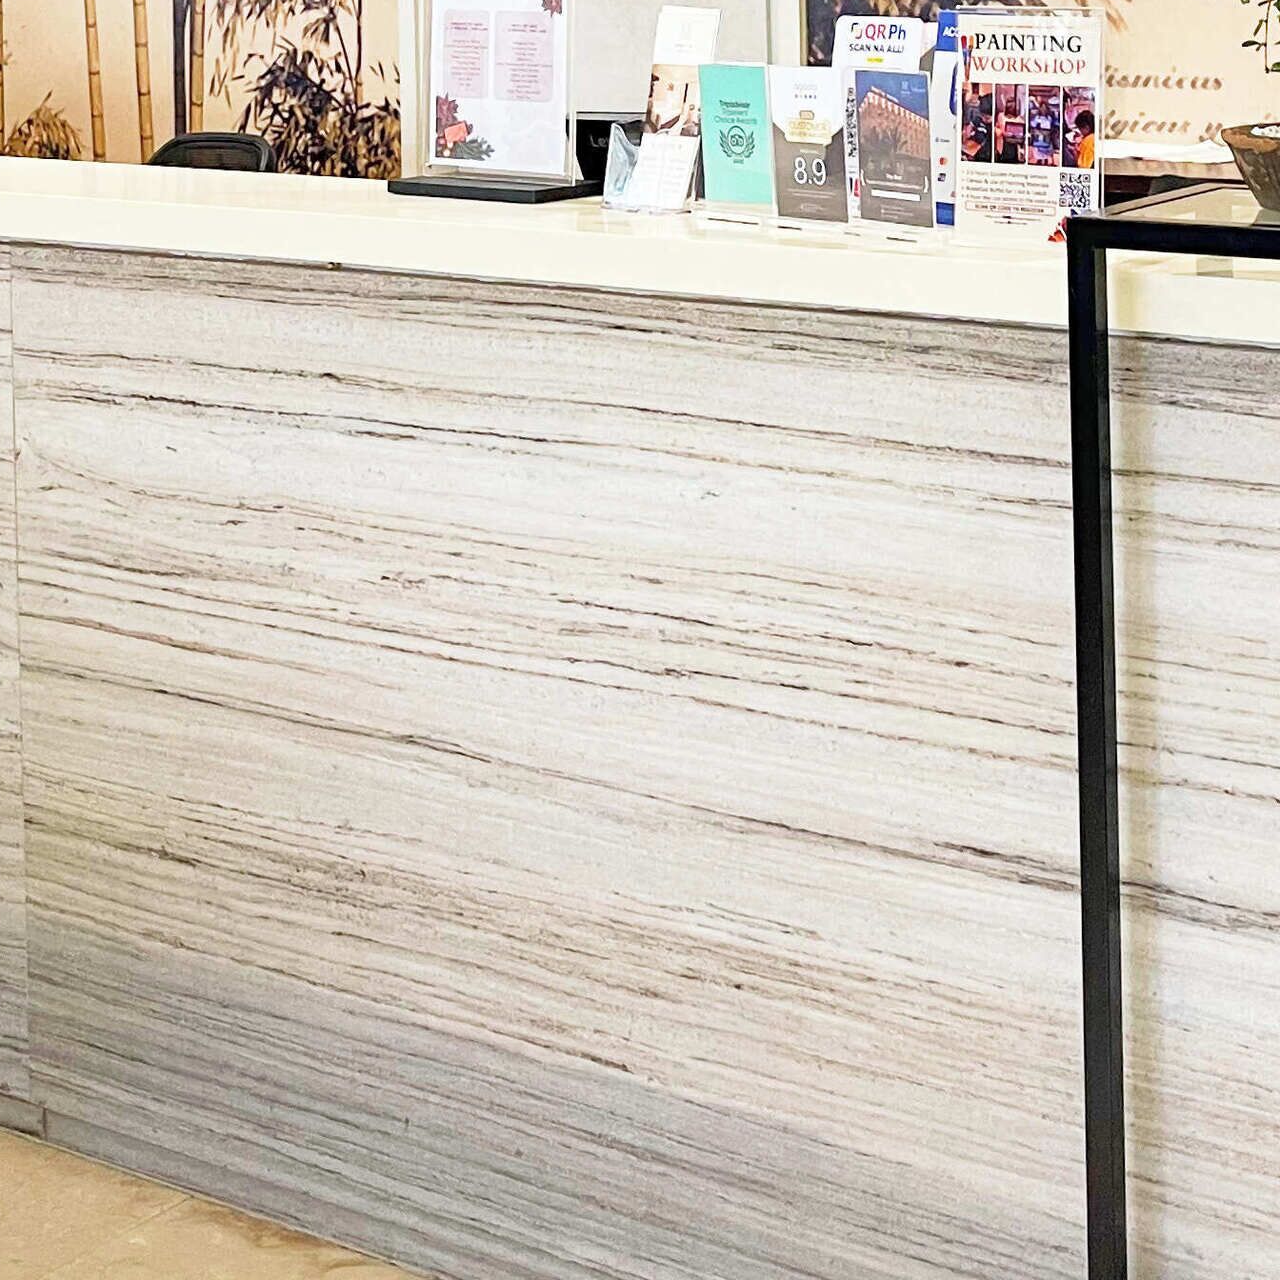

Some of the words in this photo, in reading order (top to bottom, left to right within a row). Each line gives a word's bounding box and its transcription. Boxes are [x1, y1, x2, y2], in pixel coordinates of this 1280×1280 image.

[975, 33, 1083, 54] PAINTING
[970, 55, 1087, 75] WORKSHOP
[793, 156, 827, 186] 8.9
